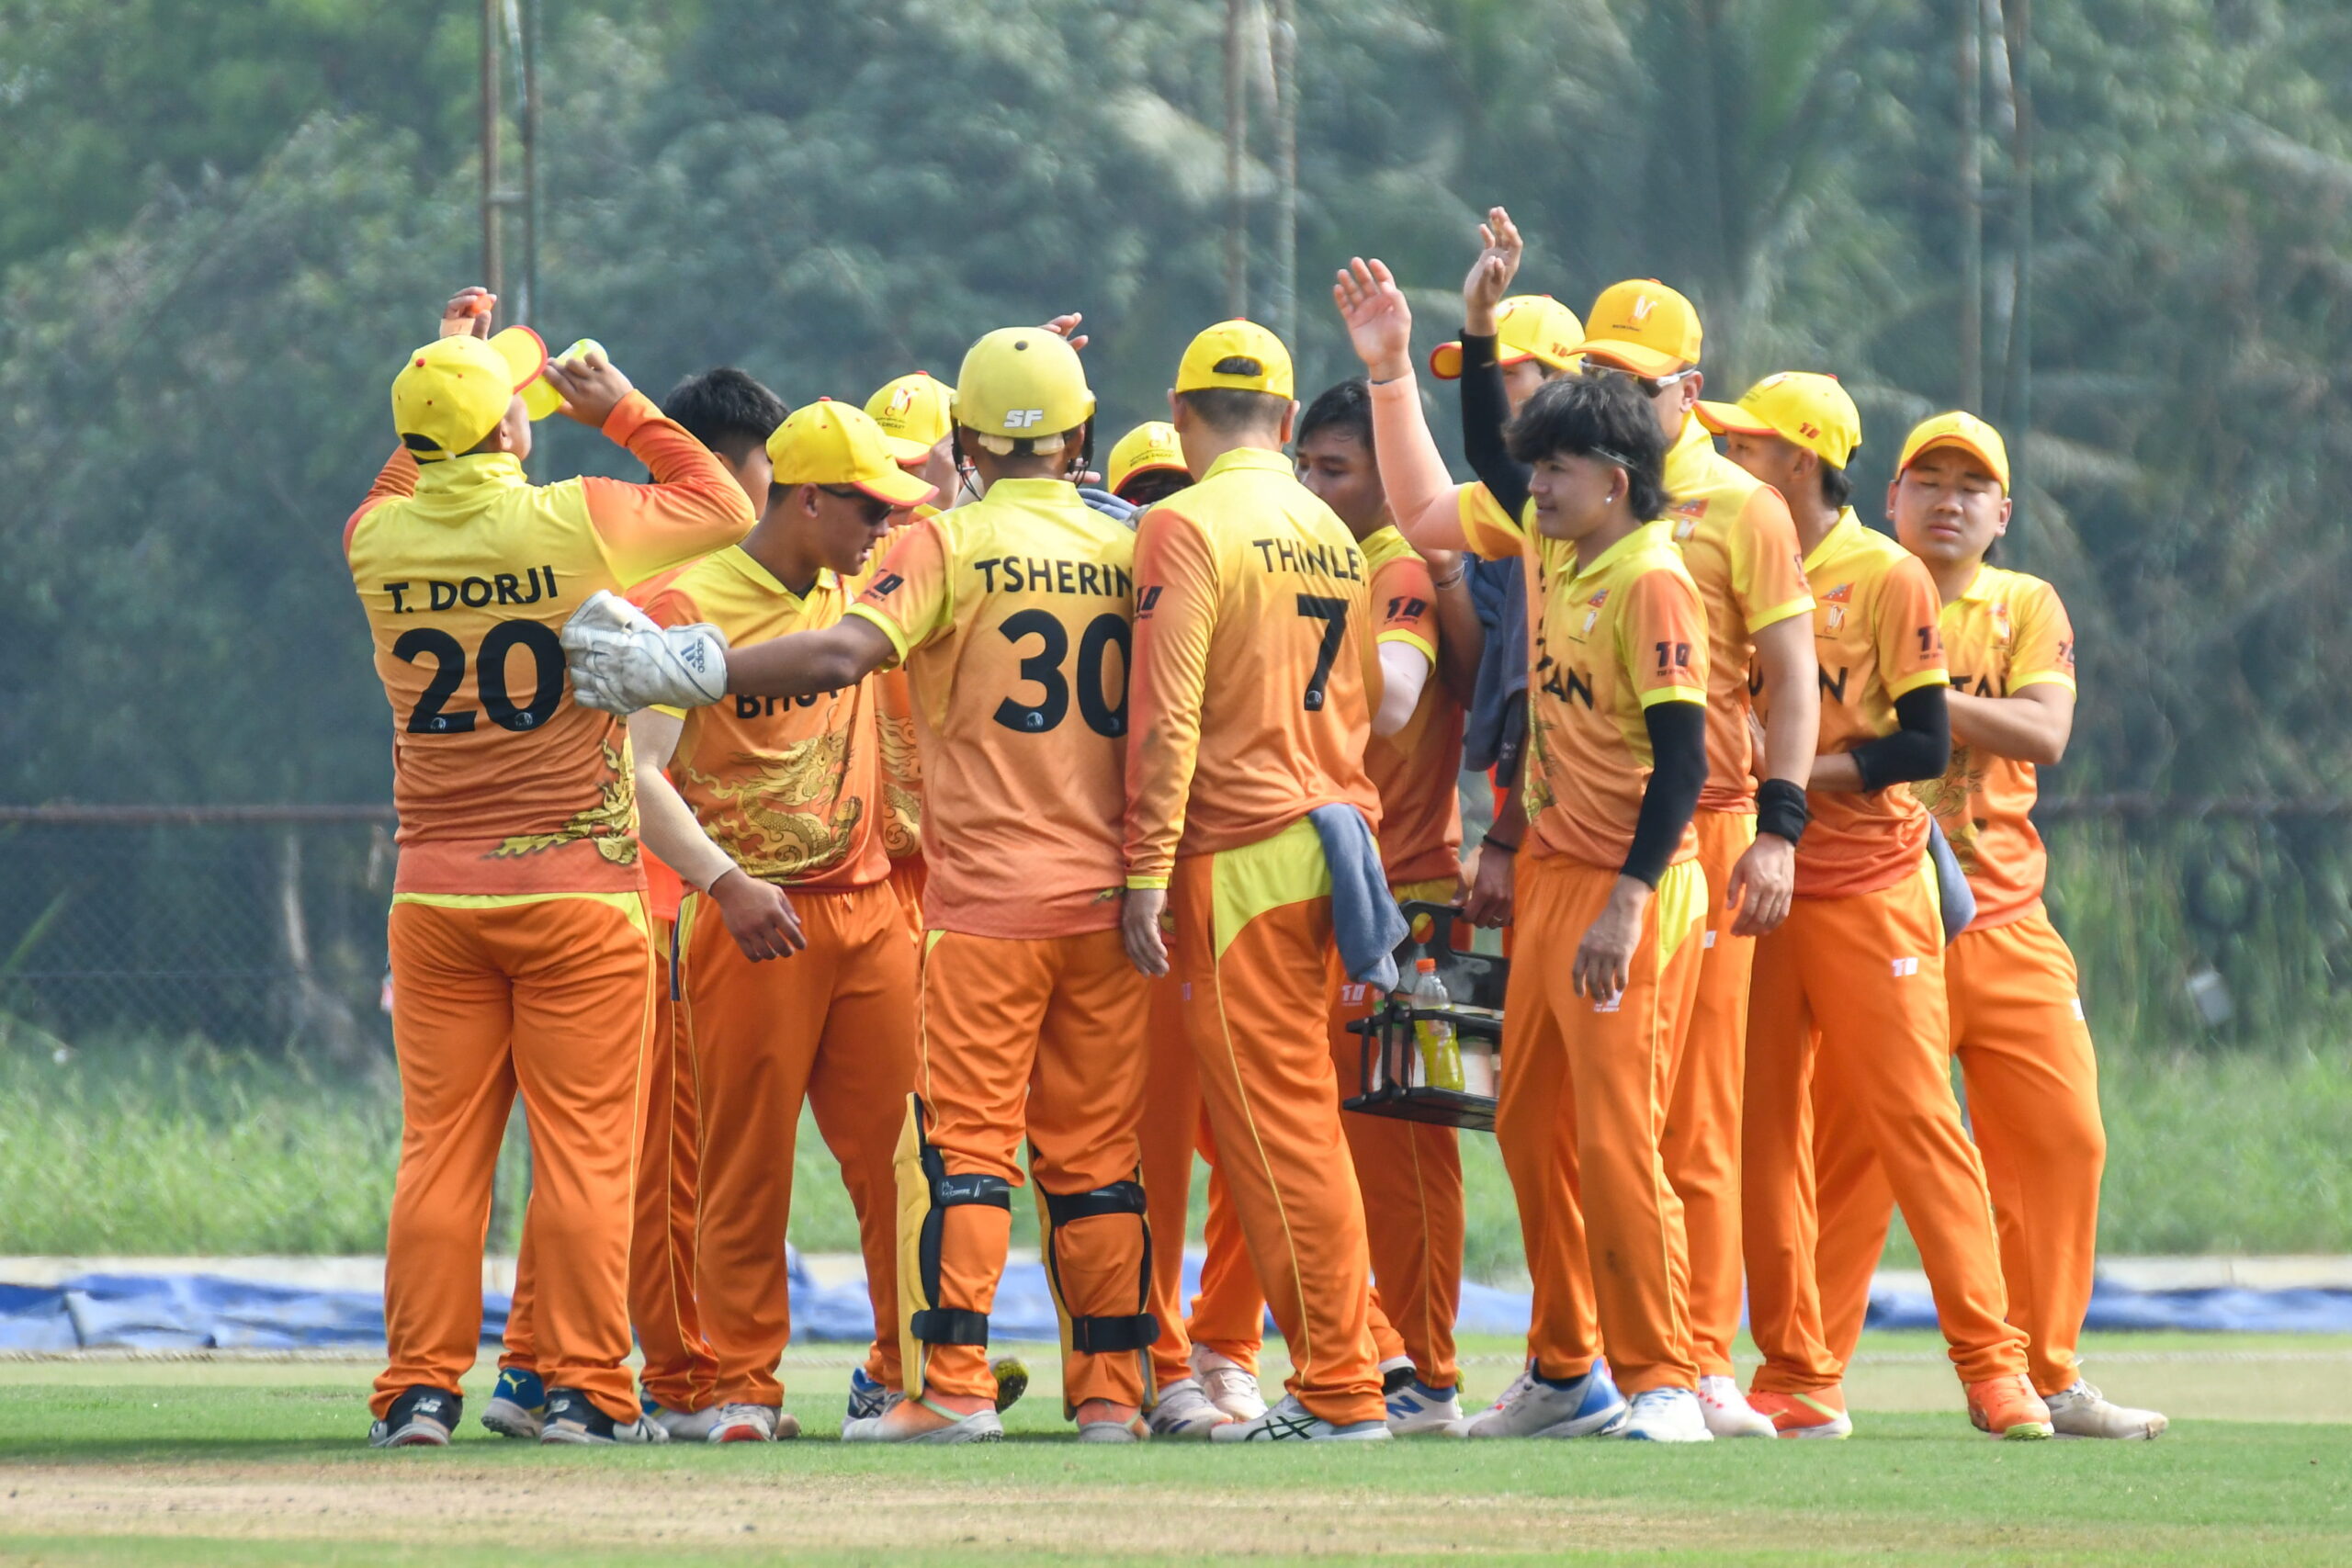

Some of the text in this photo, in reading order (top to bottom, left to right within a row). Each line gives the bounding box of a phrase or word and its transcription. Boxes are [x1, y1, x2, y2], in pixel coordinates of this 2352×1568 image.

[1003, 409, 1044, 428] SF
[383, 565, 558, 614] T. DORJI
[1252, 537, 1366, 587] THINLE
[392, 619, 566, 733] 20
[993, 608, 1132, 739] 30
[1296, 592, 1350, 711] 7
